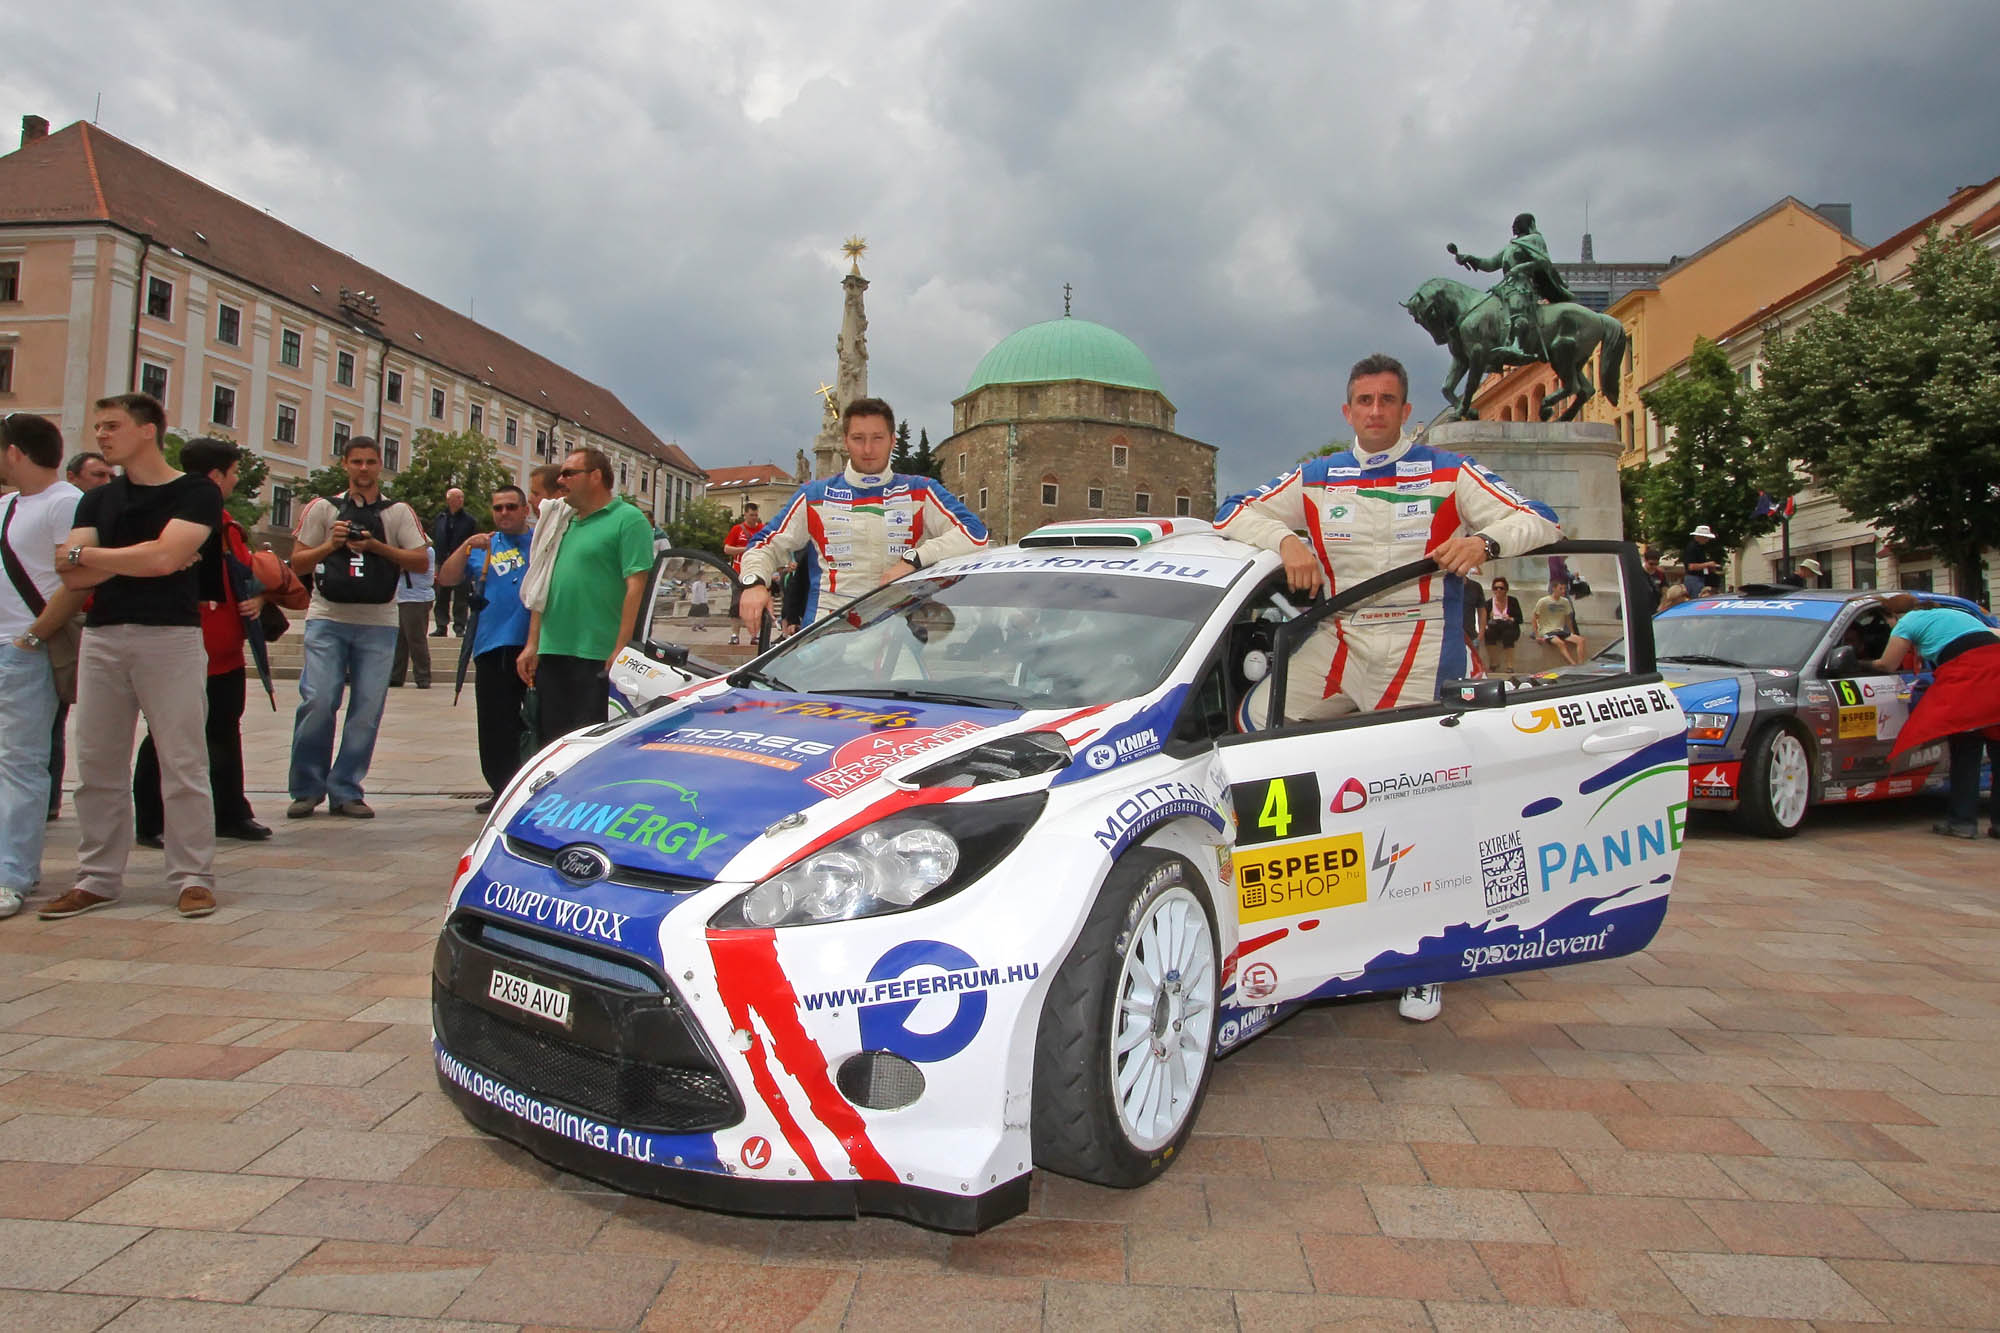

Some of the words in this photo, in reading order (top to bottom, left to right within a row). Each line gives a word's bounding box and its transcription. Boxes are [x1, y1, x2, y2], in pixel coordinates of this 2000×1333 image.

[926, 555, 1209, 578] www.ford.hu
[1840, 680, 1857, 705] 6
[1558, 703, 1586, 727] 92
[1586, 694, 1648, 722] Leticia
[1848, 712, 1876, 722] SPEED
[665, 728, 836, 756] NOREG
[873, 738, 894, 749] 4
[1116, 728, 1158, 755] KNIPL
[828, 751, 913, 793] MECSEK
[1258, 778, 1292, 837] 4
[520, 793, 728, 861] PANNERGY
[1479, 830, 1522, 857] EXTREME
[562, 851, 595, 876] Ford
[1268, 848, 1358, 880] SPEED
[1270, 873, 1340, 903] SHOP
[1388, 884, 1420, 899] Keep
[1423, 881, 1432, 892] IT
[1434, 874, 1472, 891] Simple
[485, 881, 630, 941] COMPUWORX
[493, 975, 528, 1005] PX59
[529, 991, 565, 1018] AVU
[803, 962, 1039, 1012] WWW.FEFERRUM.HU
